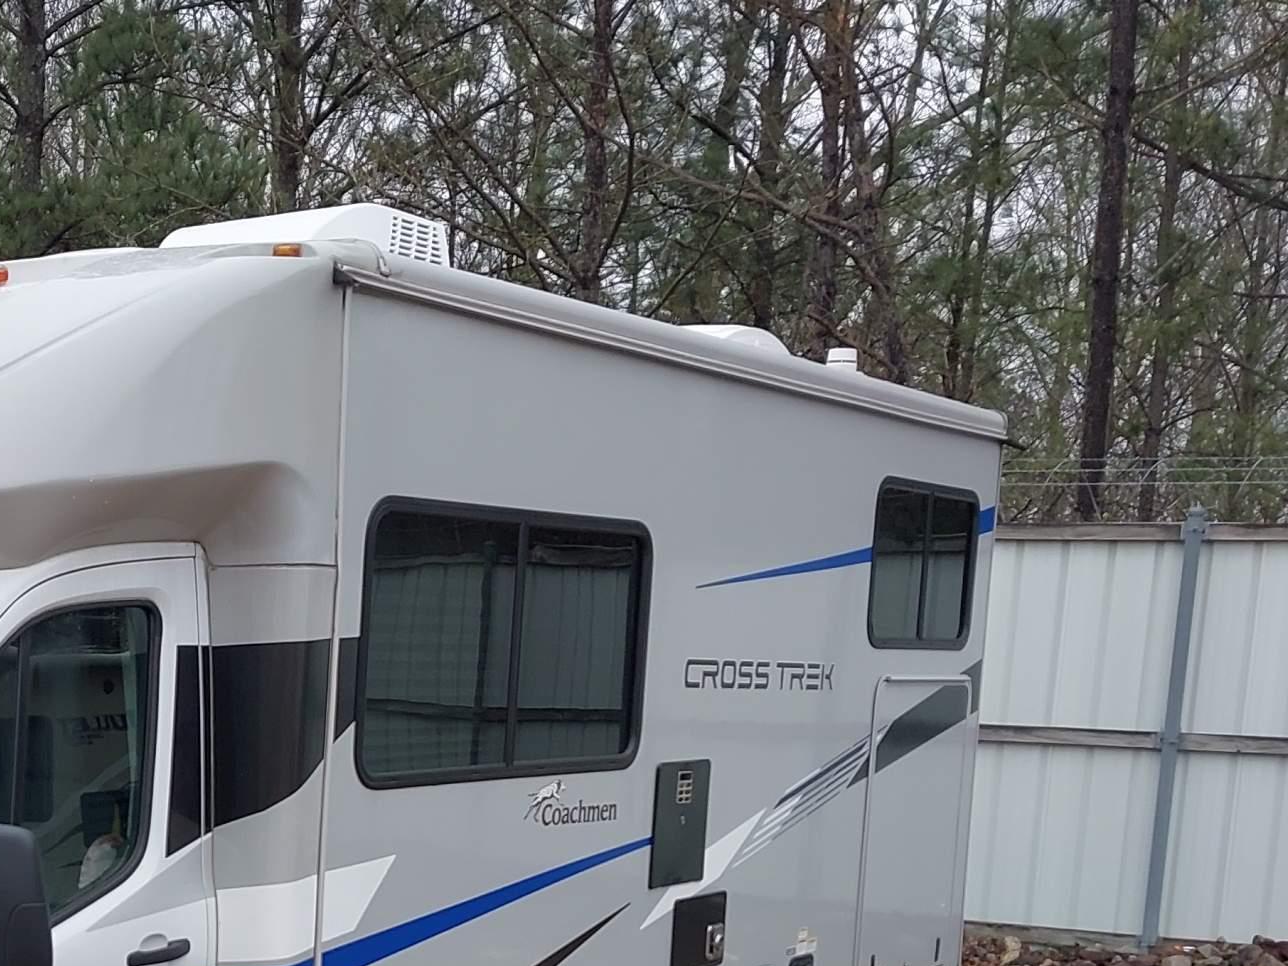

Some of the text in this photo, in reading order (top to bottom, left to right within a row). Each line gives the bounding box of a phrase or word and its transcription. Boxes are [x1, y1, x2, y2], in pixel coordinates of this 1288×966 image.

[685, 659, 834, 690] CROSS TREK
[542, 800, 617, 826] Coachmen
